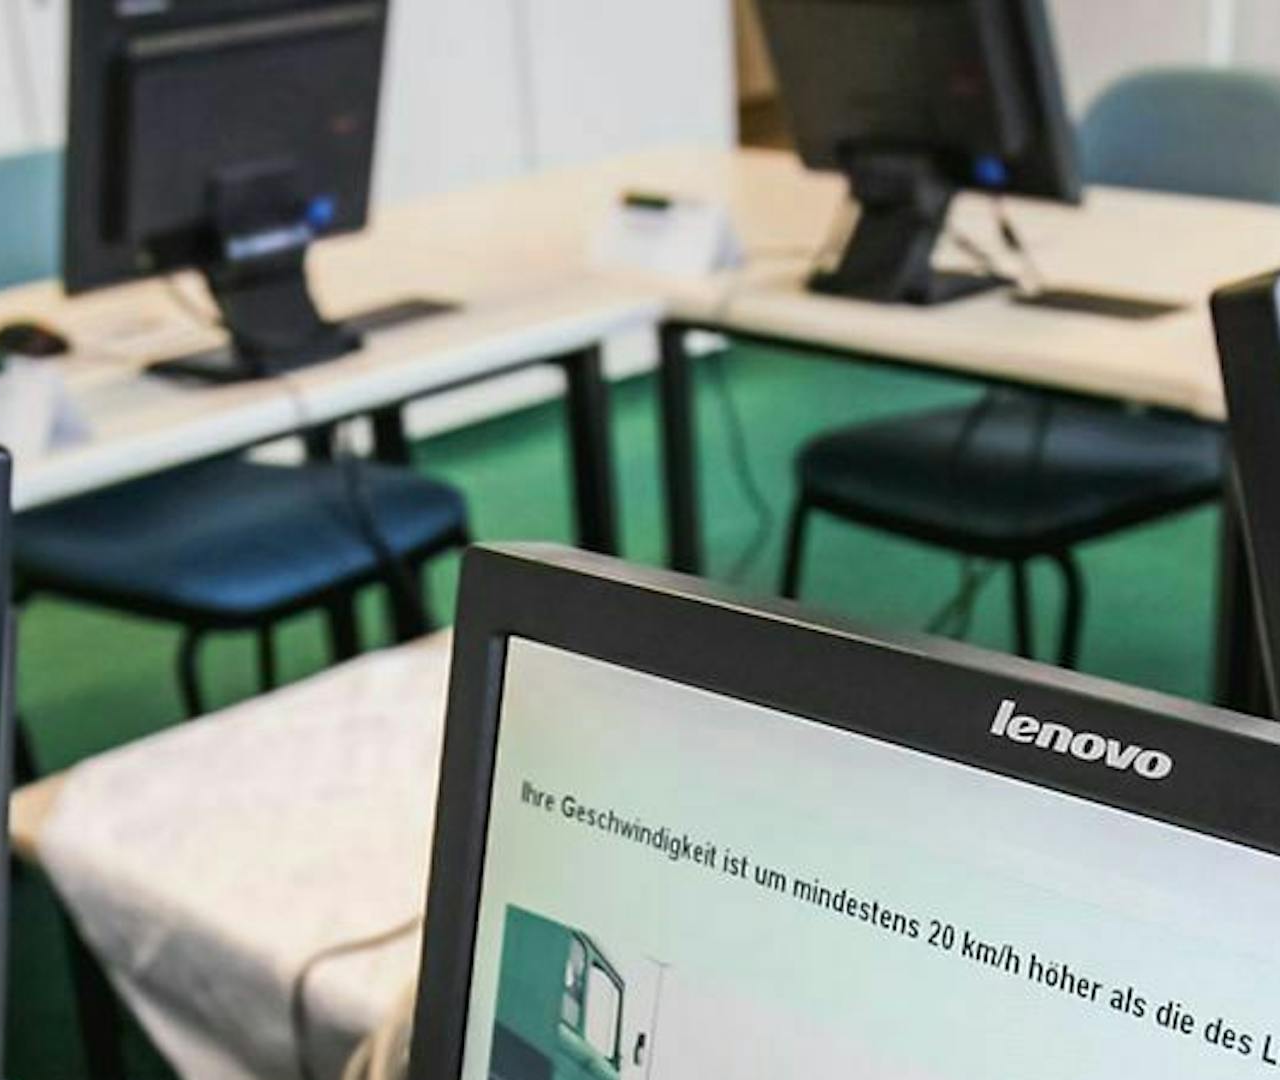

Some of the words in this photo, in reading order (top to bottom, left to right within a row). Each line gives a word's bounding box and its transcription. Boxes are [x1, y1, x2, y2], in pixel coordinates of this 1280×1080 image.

[991, 700, 1172, 780] lenovo
[522, 780, 555, 812] Ihre
[560, 795, 717, 869] Geschwindigkeit
[722, 848, 748, 880] ist
[754, 862, 787, 893] um
[793, 878, 920, 940] mindestens
[927, 920, 955, 951] 20
[961, 930, 1020, 976] km/h
[1028, 954, 1103, 1003] höher
[1109, 986, 1147, 1020] als
[1154, 1000, 1195, 1036] die
[1204, 1018, 1253, 1055] des
